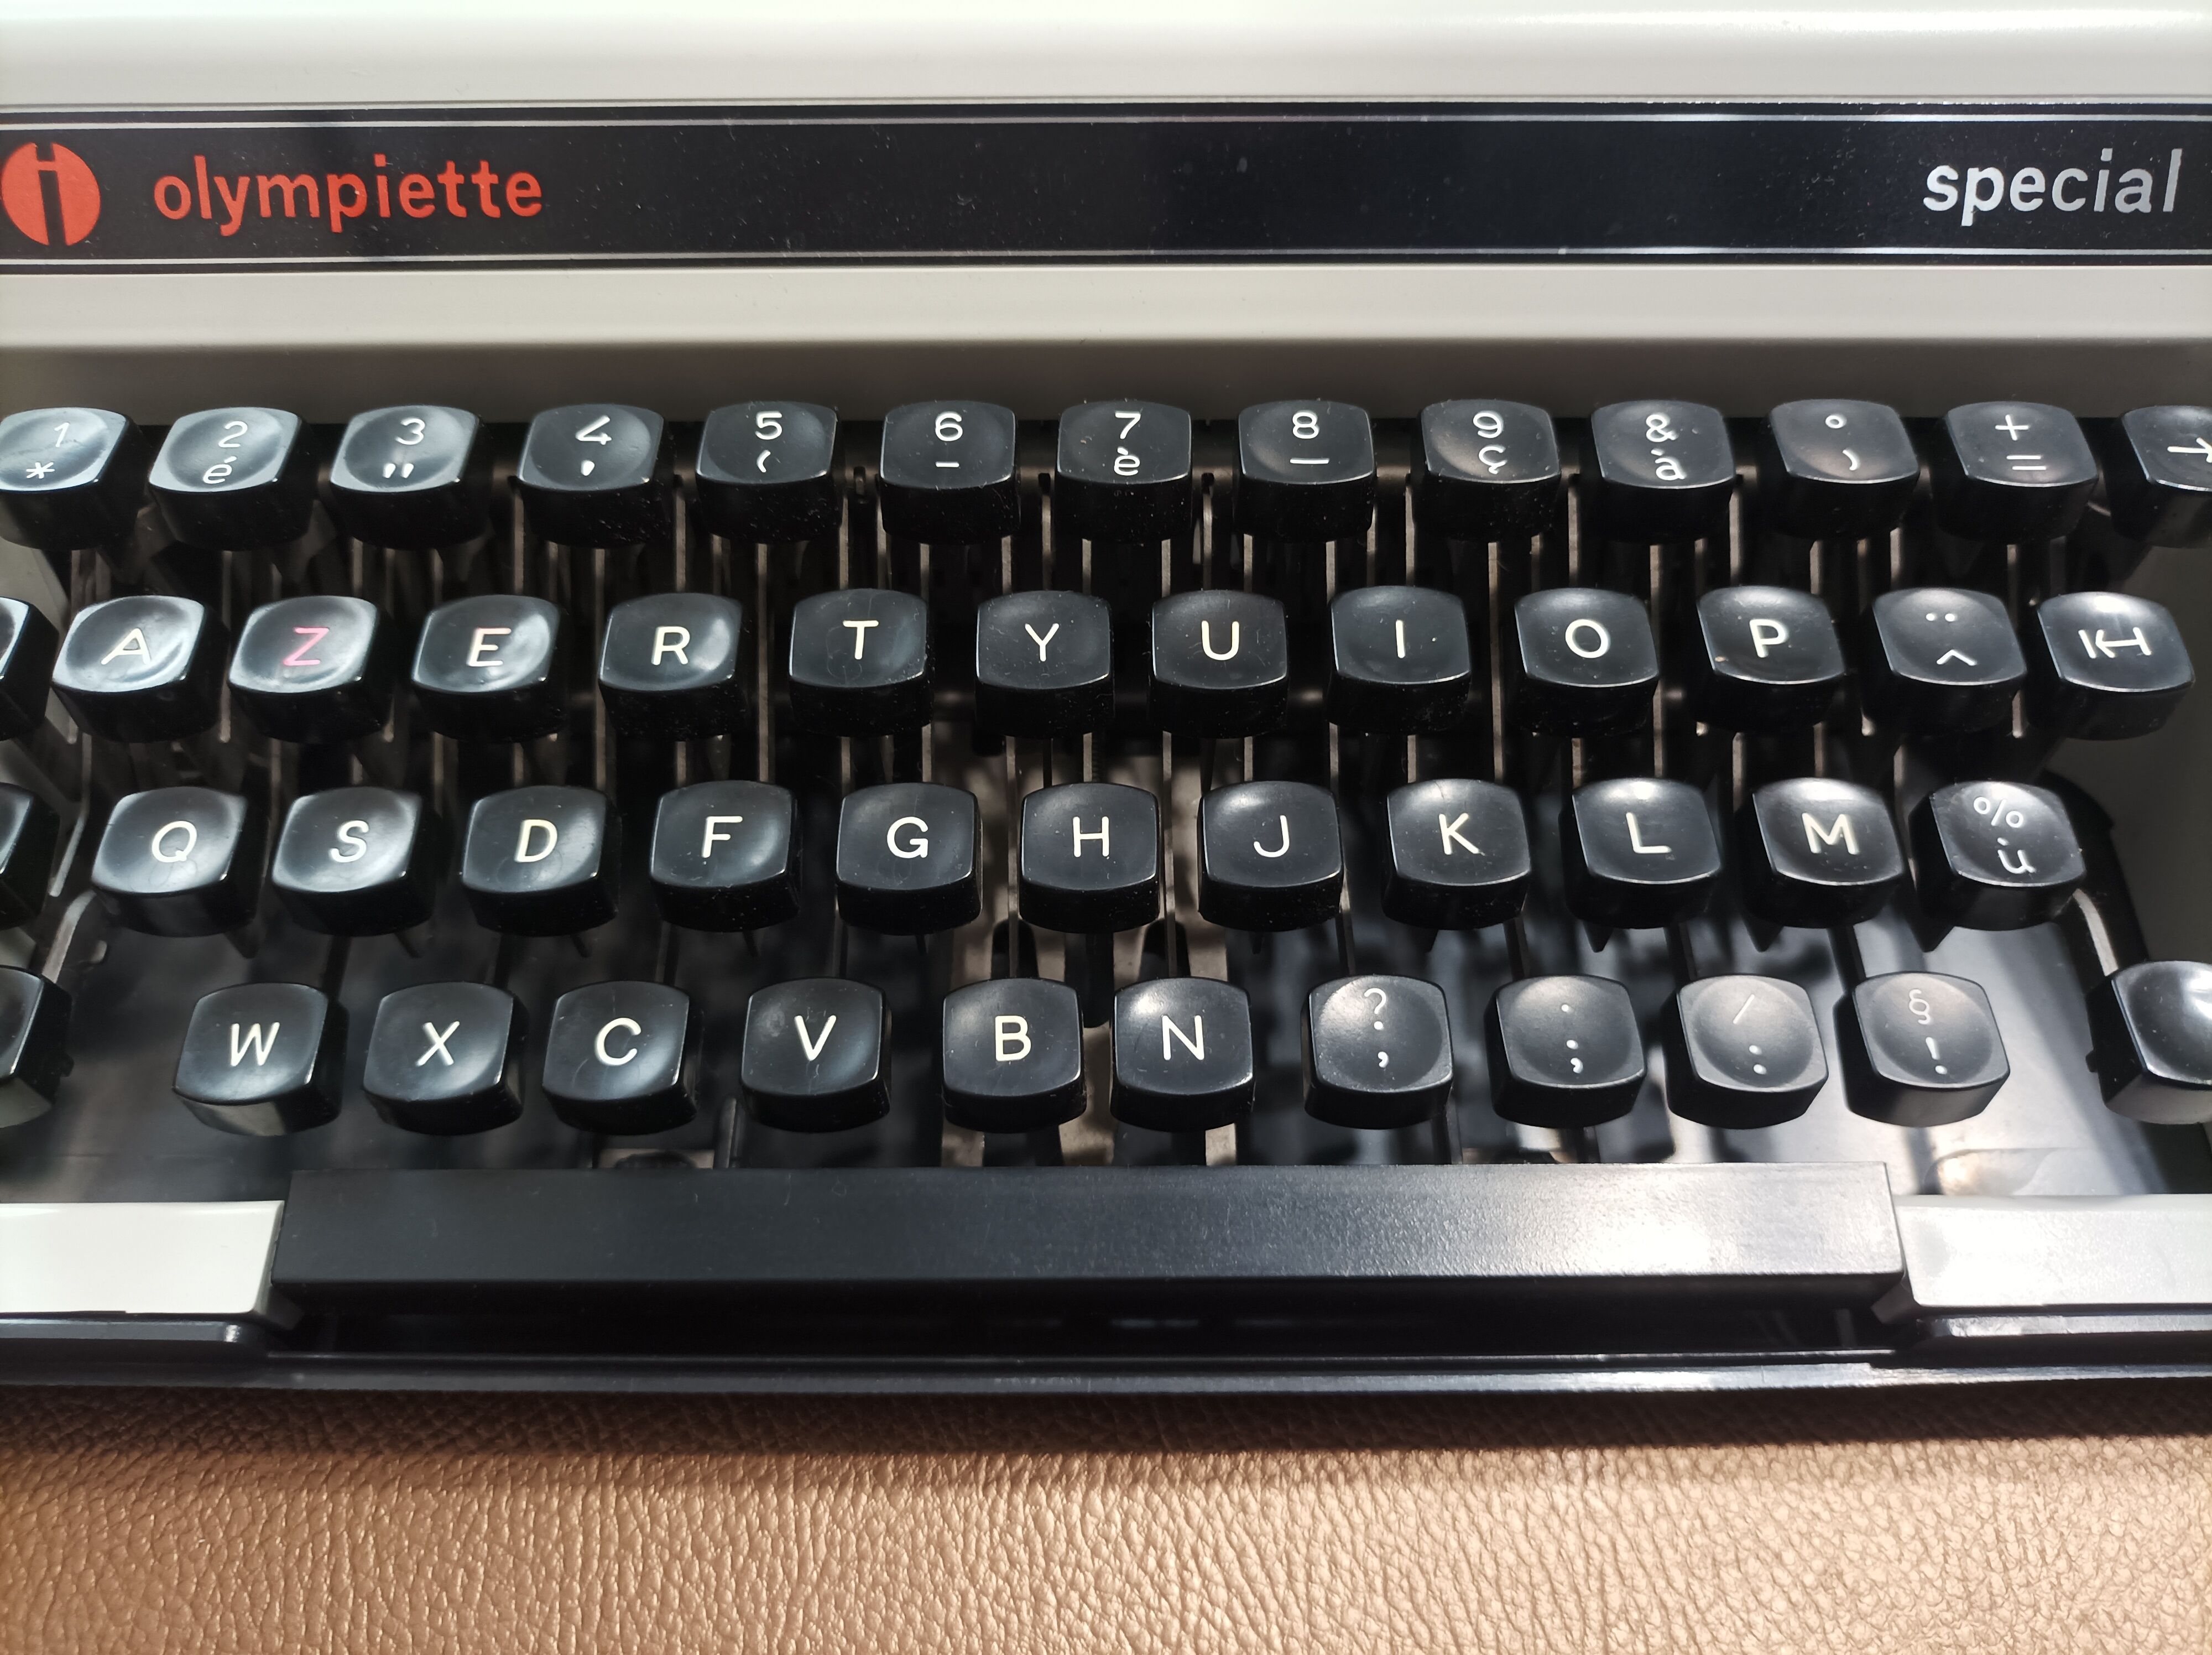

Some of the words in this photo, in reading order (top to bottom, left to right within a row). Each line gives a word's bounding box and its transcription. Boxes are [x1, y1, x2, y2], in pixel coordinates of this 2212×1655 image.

[153, 154, 542, 237] olympiette
[1923, 147, 2183, 227] special
[54, 422, 70, 447] 1
[218, 420, 248, 448] 2
[395, 418, 426, 445] 3
[576, 415, 611, 445] 4
[755, 412, 782, 440] 5
[934, 412, 963, 442] 6
[1114, 411, 1141, 440] 7
[1292, 410, 1320, 440] 8
[1472, 412, 1504, 439] 9
[1645, 414, 1676, 443] &
[1994, 414, 2030, 440] +
[203, 456, 237, 484] é
[756, 450, 771, 472] (
[1113, 447, 1141, 476] è
[1478, 446, 1506, 475] ç
[1650, 447, 1686, 481] à
[1841, 449, 1860, 471] )
[2006, 454, 2047, 471] =
[101, 628, 150, 665] A
[283, 627, 330, 666] Z
[468, 627, 512, 666] E
[651, 626, 690, 665] R
[842, 620, 879, 660] T
[1024, 623, 1060, 662] Y
[1201, 621, 1239, 660] U
[1395, 620, 1406, 659] I
[1564, 618, 1610, 659] O
[1748, 618, 1787, 658] P
[1973, 795, 2025, 829] %
[151, 820, 198, 863] Q
[330, 819, 369, 863] S
[514, 819, 559, 862] D
[701, 815, 742, 858] F
[886, 816, 929, 859] G
[1072, 816, 1109, 857] H
[1253, 815, 1290, 858] J
[1439, 813, 1481, 855] K
[1626, 811, 1672, 855] L
[1802, 812, 1860, 855] M
[1364, 987, 1387, 1031] ?
[1733, 993, 1755, 1024] /
[1908, 989, 1932, 1025] §
[228, 1021, 281, 1066] W
[415, 1021, 460, 1066] X
[594, 1017, 641, 1066] C
[794, 1014, 837, 1062] V
[995, 1015, 1031, 1063] B
[1161, 1014, 1204, 1061] N
[1566, 1039, 1583, 1074] ;
[1925, 1037, 1948, 1076] !
[1377, 1050, 1390, 1068] ,
[1749, 1045, 1767, 1075] :
